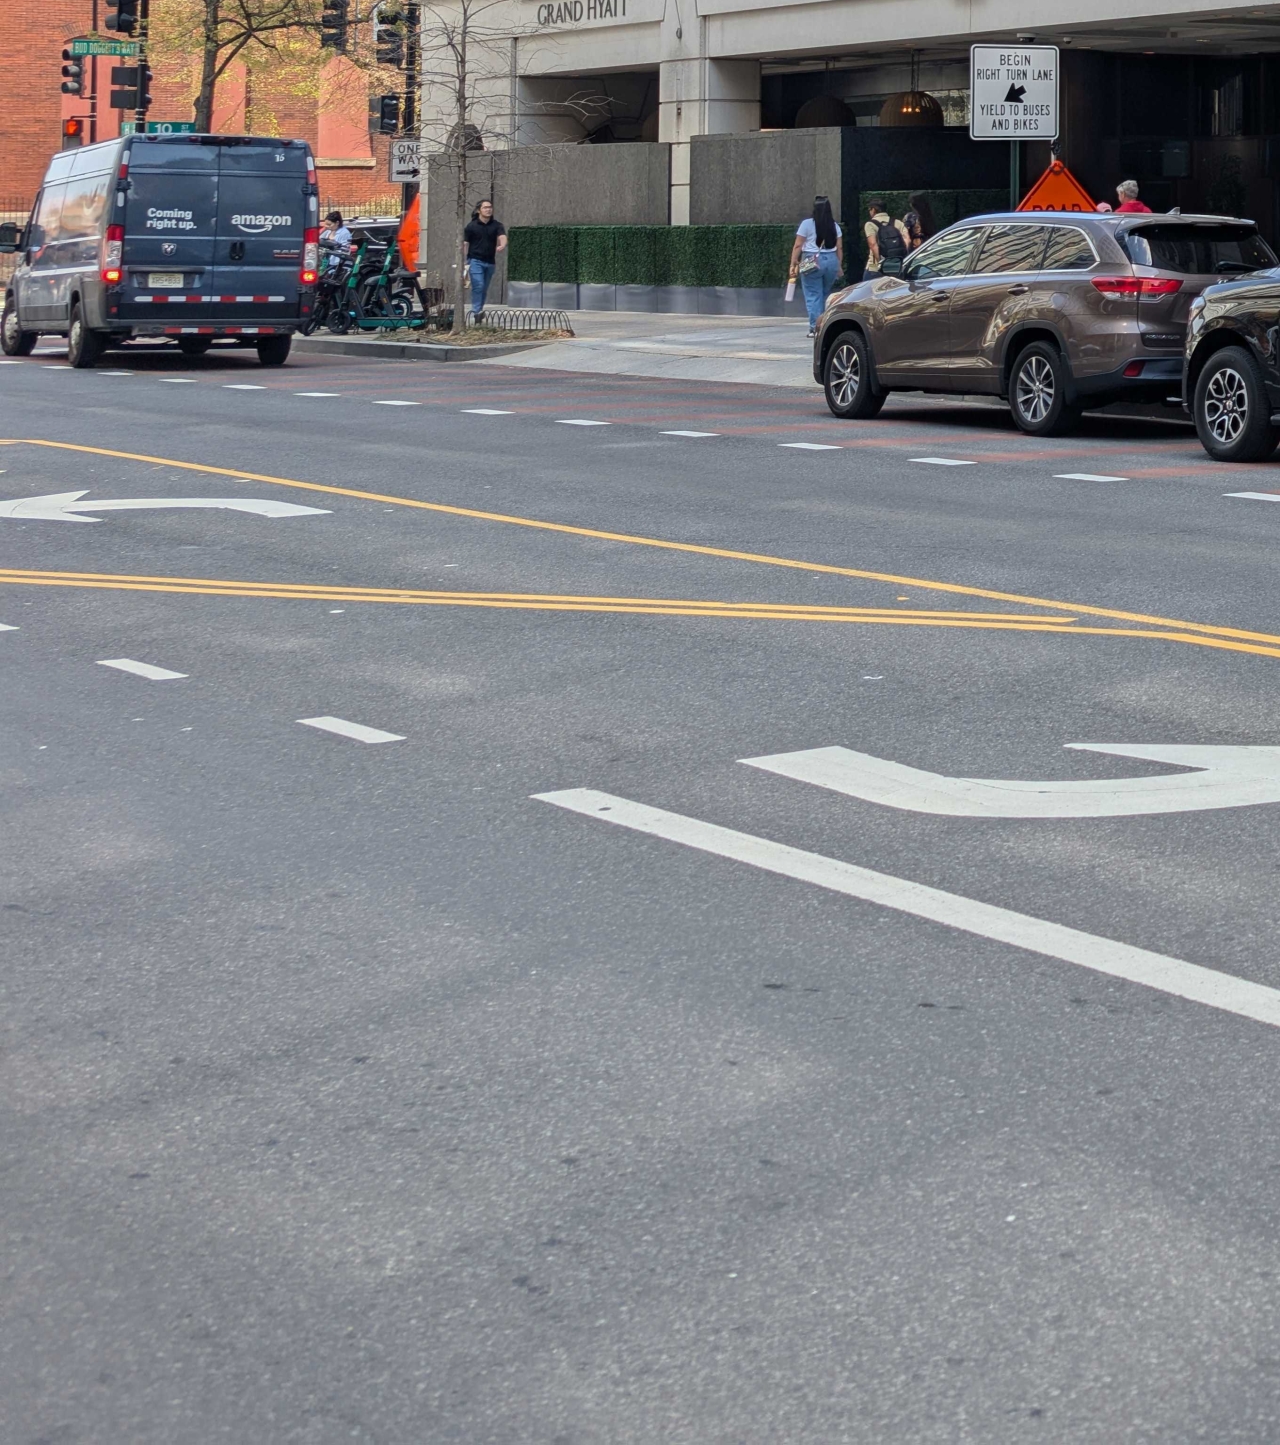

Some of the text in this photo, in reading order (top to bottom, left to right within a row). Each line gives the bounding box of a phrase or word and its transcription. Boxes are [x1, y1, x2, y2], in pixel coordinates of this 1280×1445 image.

[537, 0, 583, 25] GRAND
[74, 42, 87, 53] BUD
[121, 42, 135, 54] WAY
[999, 54, 1031, 66] BEGIN
[976, 68, 1053, 81] RIGHT TURN LANE
[980, 104, 1050, 116] YIELD TO BUSES
[154, 123, 173, 134] 10
[991, 118, 1039, 130] AND BIKES
[398, 144, 421, 153] ONE
[398, 155, 421, 164] WAY
[147, 208, 192, 220] Coming
[231, 214, 291, 226] amazon
[146, 218, 197, 230] right up.
